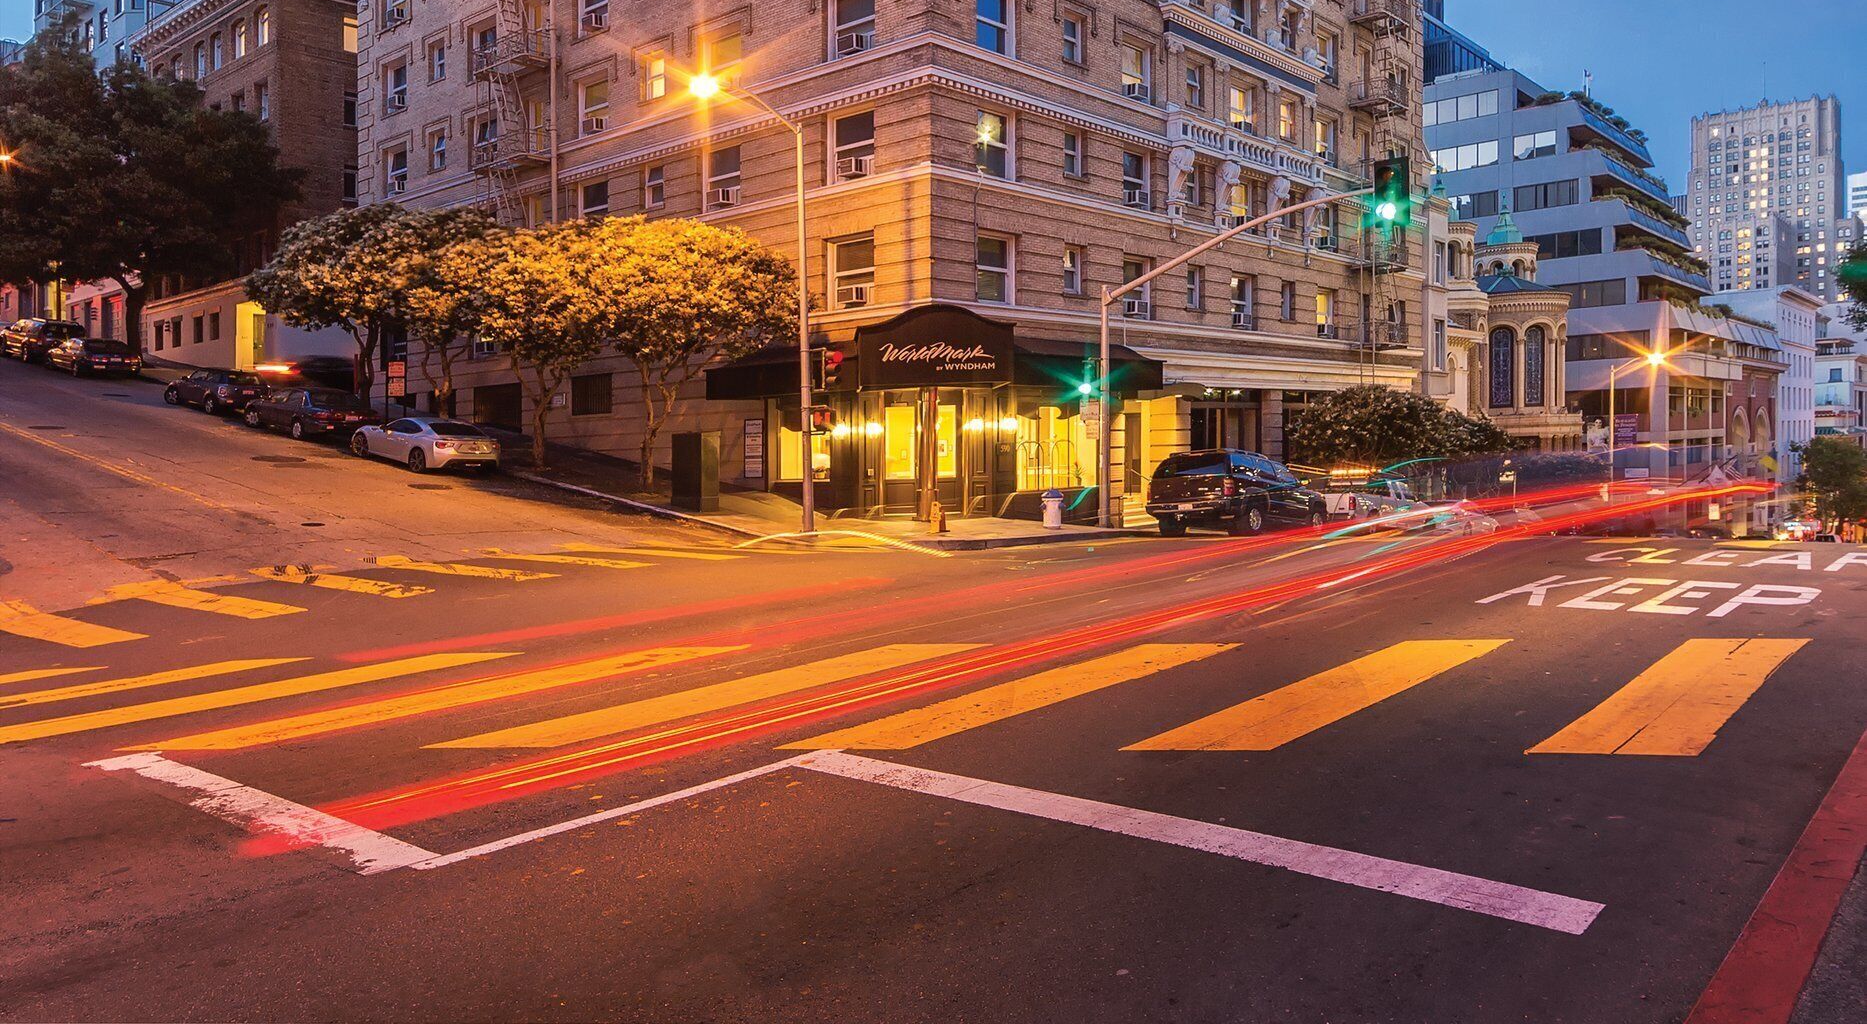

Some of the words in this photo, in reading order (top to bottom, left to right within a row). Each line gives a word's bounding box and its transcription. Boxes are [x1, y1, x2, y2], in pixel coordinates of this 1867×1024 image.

[879, 341, 995, 364] WorldMark
[945, 362, 996, 371] WYNDHAM
[1475, 575, 1822, 617] KEEP
